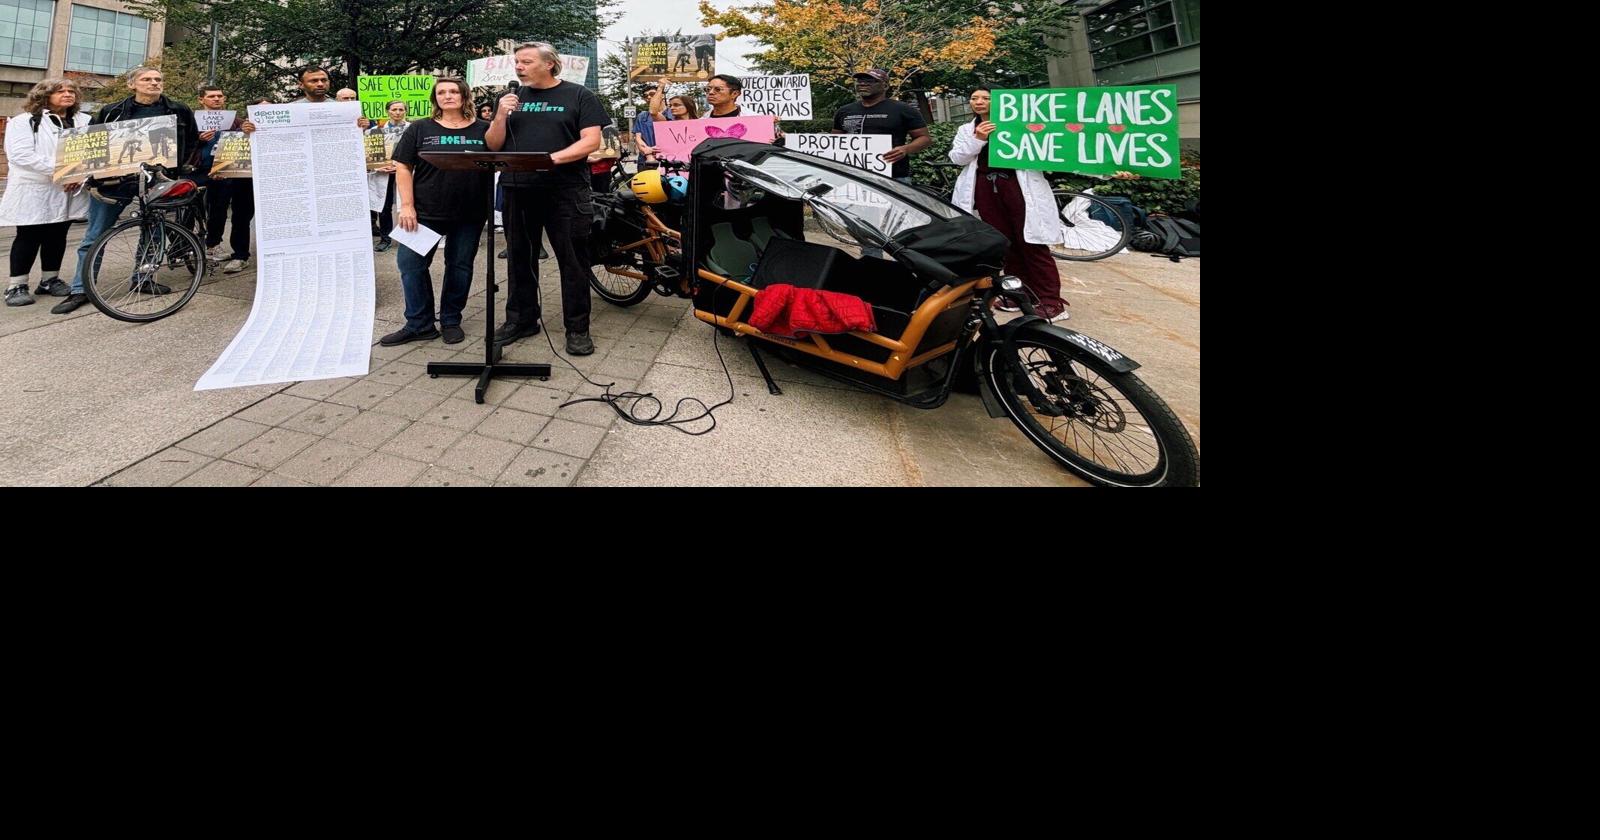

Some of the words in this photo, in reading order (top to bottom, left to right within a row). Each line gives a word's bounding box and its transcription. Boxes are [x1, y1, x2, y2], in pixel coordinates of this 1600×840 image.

[359, 77, 383, 91] SAFE
[387, 77, 430, 91] CYCLING
[738, 76, 769, 90] OTECT
[769, 75, 808, 89] ONTARIO
[743, 88, 802, 102] ROTECT
[361, 101, 388, 118] PUBL
[405, 100, 432, 117] EALTH
[741, 101, 810, 117] TARIANS
[1000, 93, 1066, 122] BIKE
[1077, 90, 1172, 125] LANES
[76, 131, 108, 140] SAFER
[668, 126, 697, 144] We
[798, 135, 872, 150] PROTECT
[65, 140, 108, 152] MEANS
[997, 131, 1064, 162] SAVE
[1078, 132, 1172, 168] LIVES
